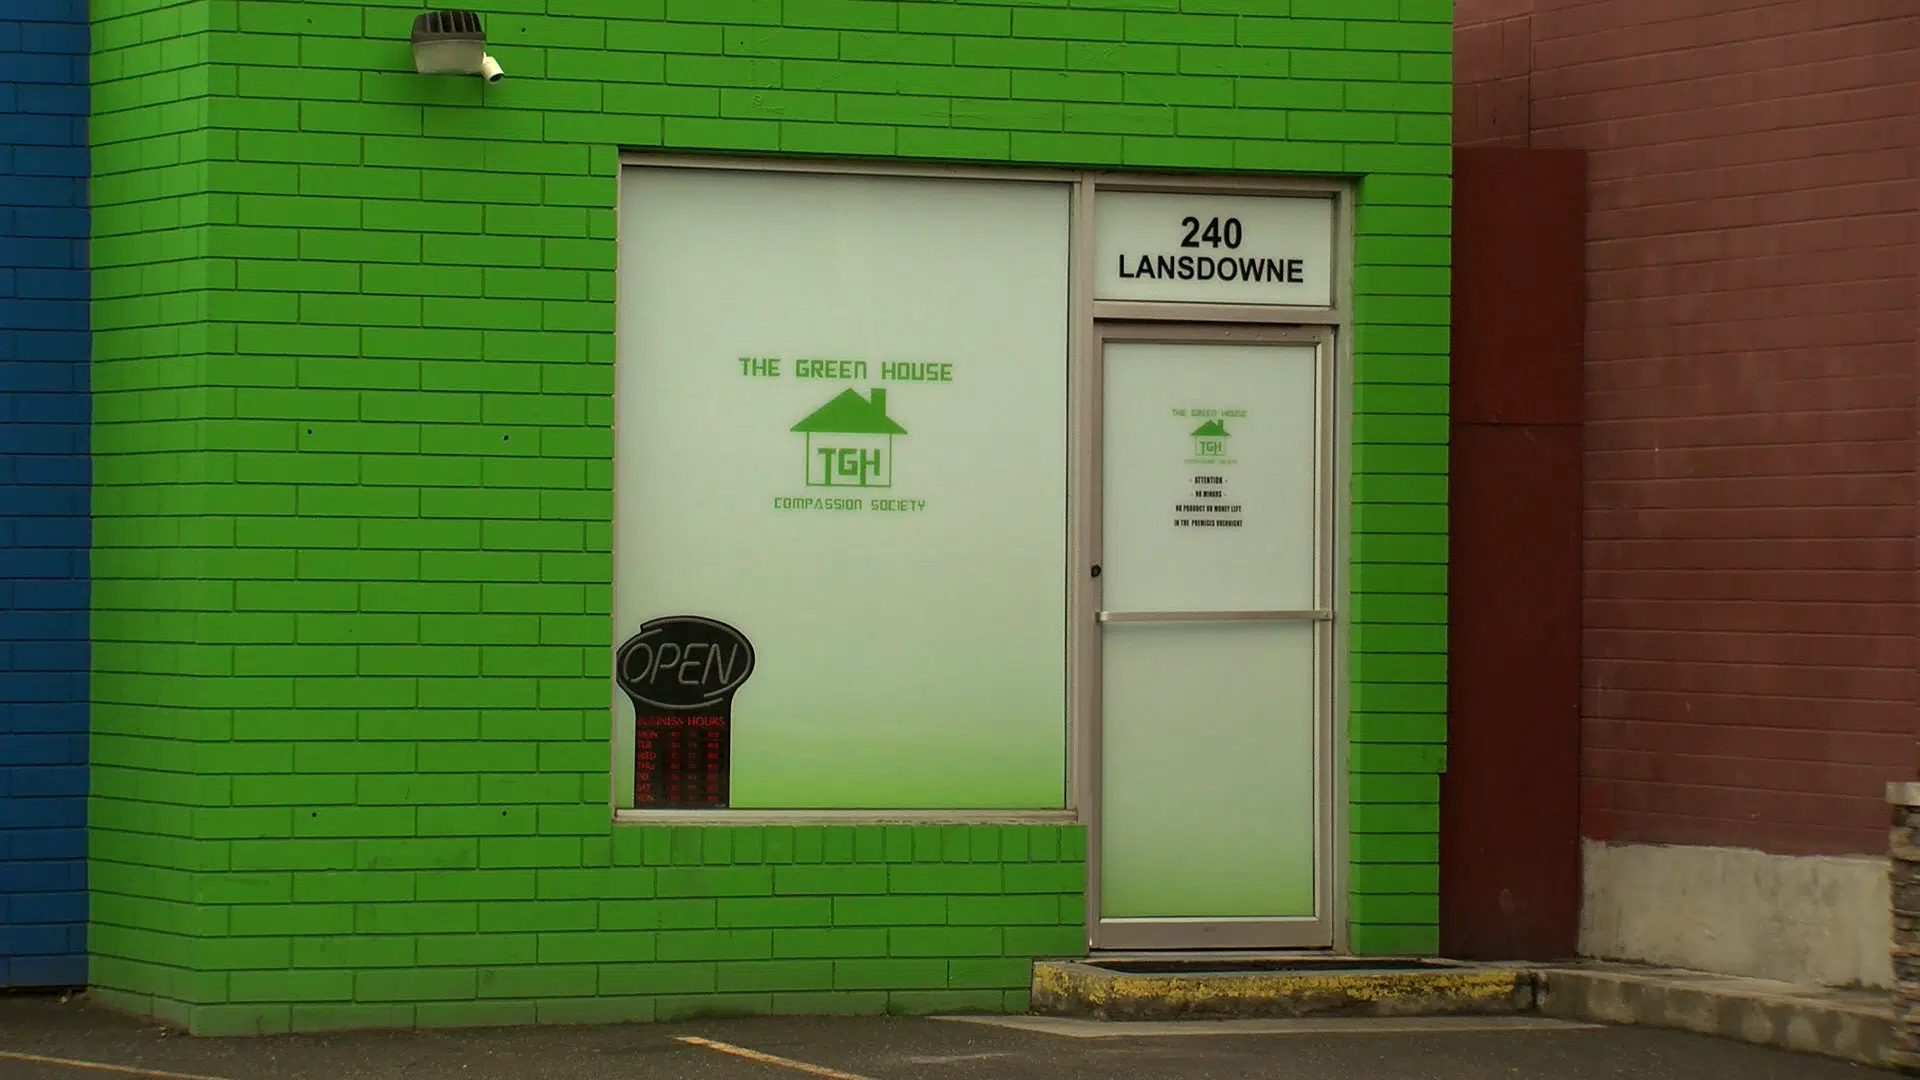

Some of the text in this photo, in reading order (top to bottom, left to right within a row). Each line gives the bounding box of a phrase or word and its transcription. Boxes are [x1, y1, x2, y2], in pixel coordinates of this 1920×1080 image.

[1181, 216, 1242, 249] 240
[1119, 254, 1304, 283] LANSDOWNE
[738, 357, 953, 381] THE GREEN HOUSE
[1172, 408, 1187, 417] THE
[1191, 409, 1217, 417] GREEN
[1199, 441, 1222, 456] TGH
[817, 448, 881, 487] TGH
[1194, 476, 1223, 484] ATTENTION
[1195, 490, 1202, 498] NO
[774, 497, 925, 512] COMPASSION SOCIETY
[623, 643, 738, 685] OPEN
[637, 716, 725, 726] INESS HOURS
